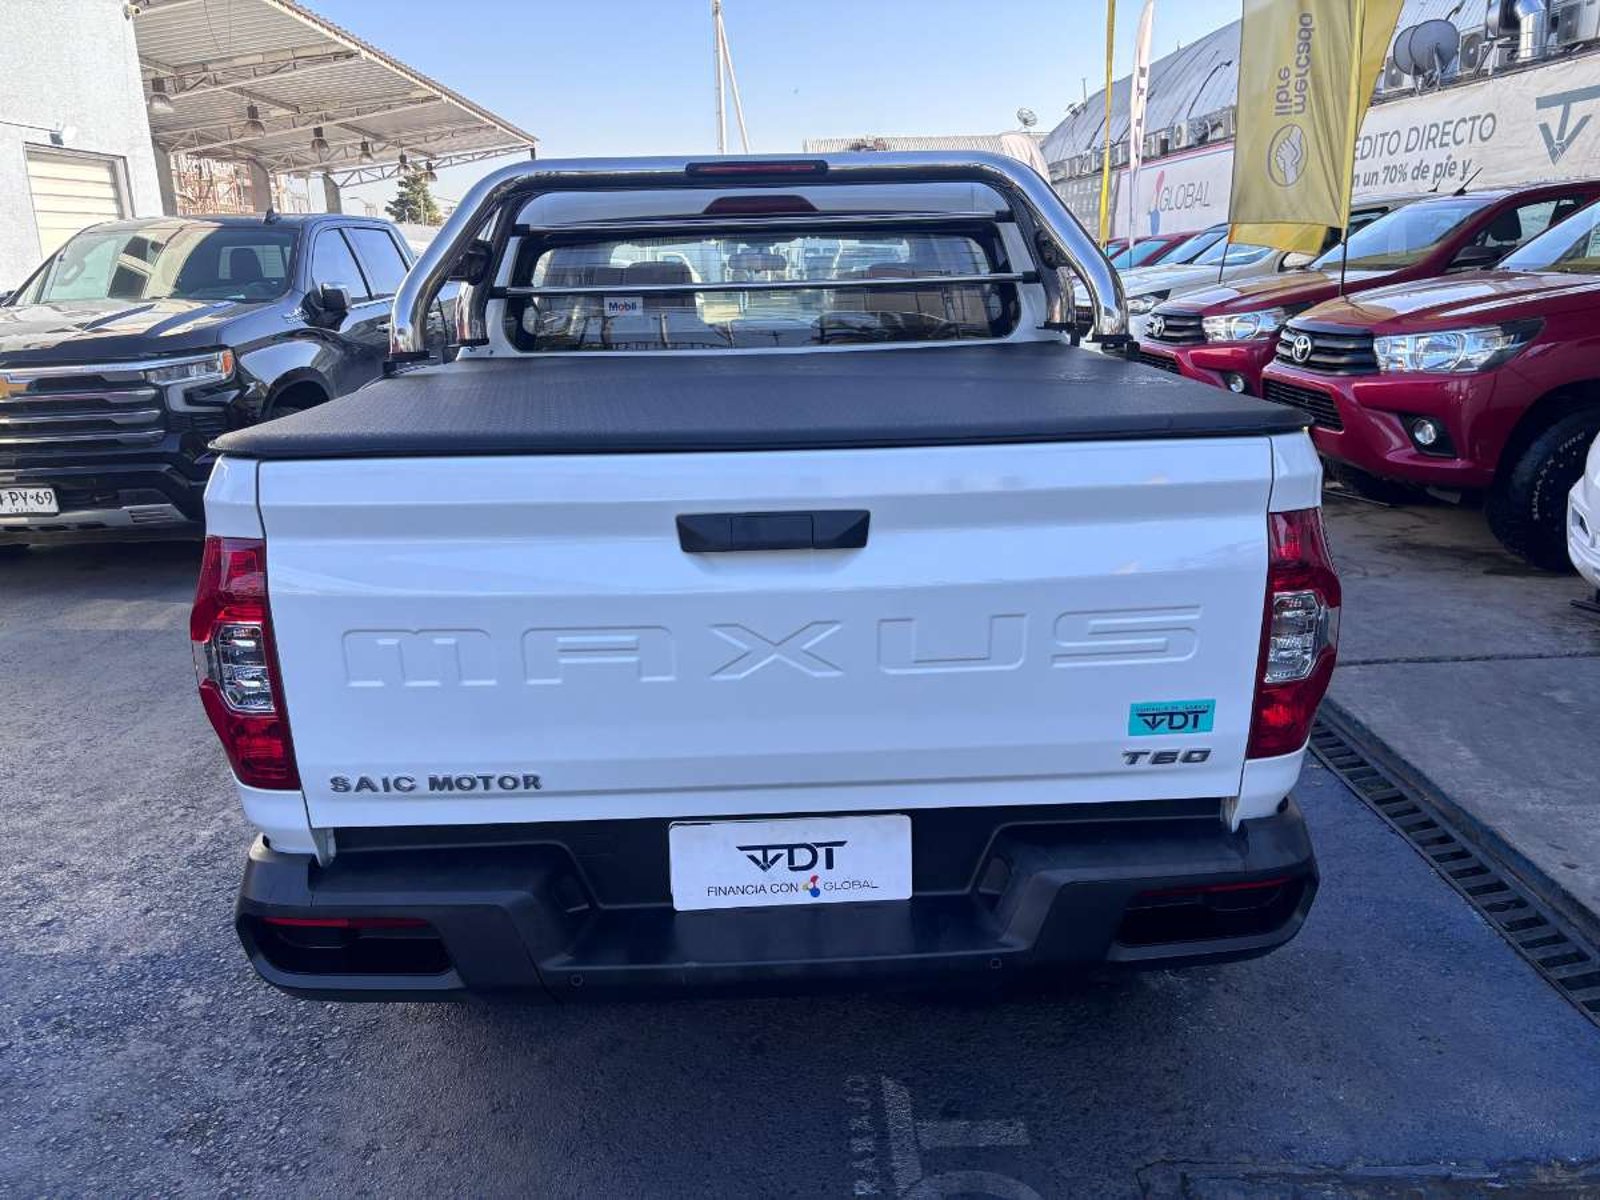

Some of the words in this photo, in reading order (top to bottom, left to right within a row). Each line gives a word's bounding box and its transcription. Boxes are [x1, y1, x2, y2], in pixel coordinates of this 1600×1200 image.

[1404, 112, 1497, 153] DIRECTO
[1363, 169, 1379, 188] un
[1382, 162, 1408, 185] 70%
[1411, 159, 1430, 181] de
[1460, 158, 1473, 182] y
[1159, 180, 1211, 212] GLOBAL
[609, 299, 637, 311] Mobil
[341, 605, 1201, 688] MAXUS
[1121, 750, 1212, 766] T60
[329, 776, 417, 793] SAIC
[428, 774, 543, 792] MOTOR
[706, 882, 768, 897] FINANCIA
[770, 882, 799, 894] CON
[823, 879, 879, 891] GLOBAL
